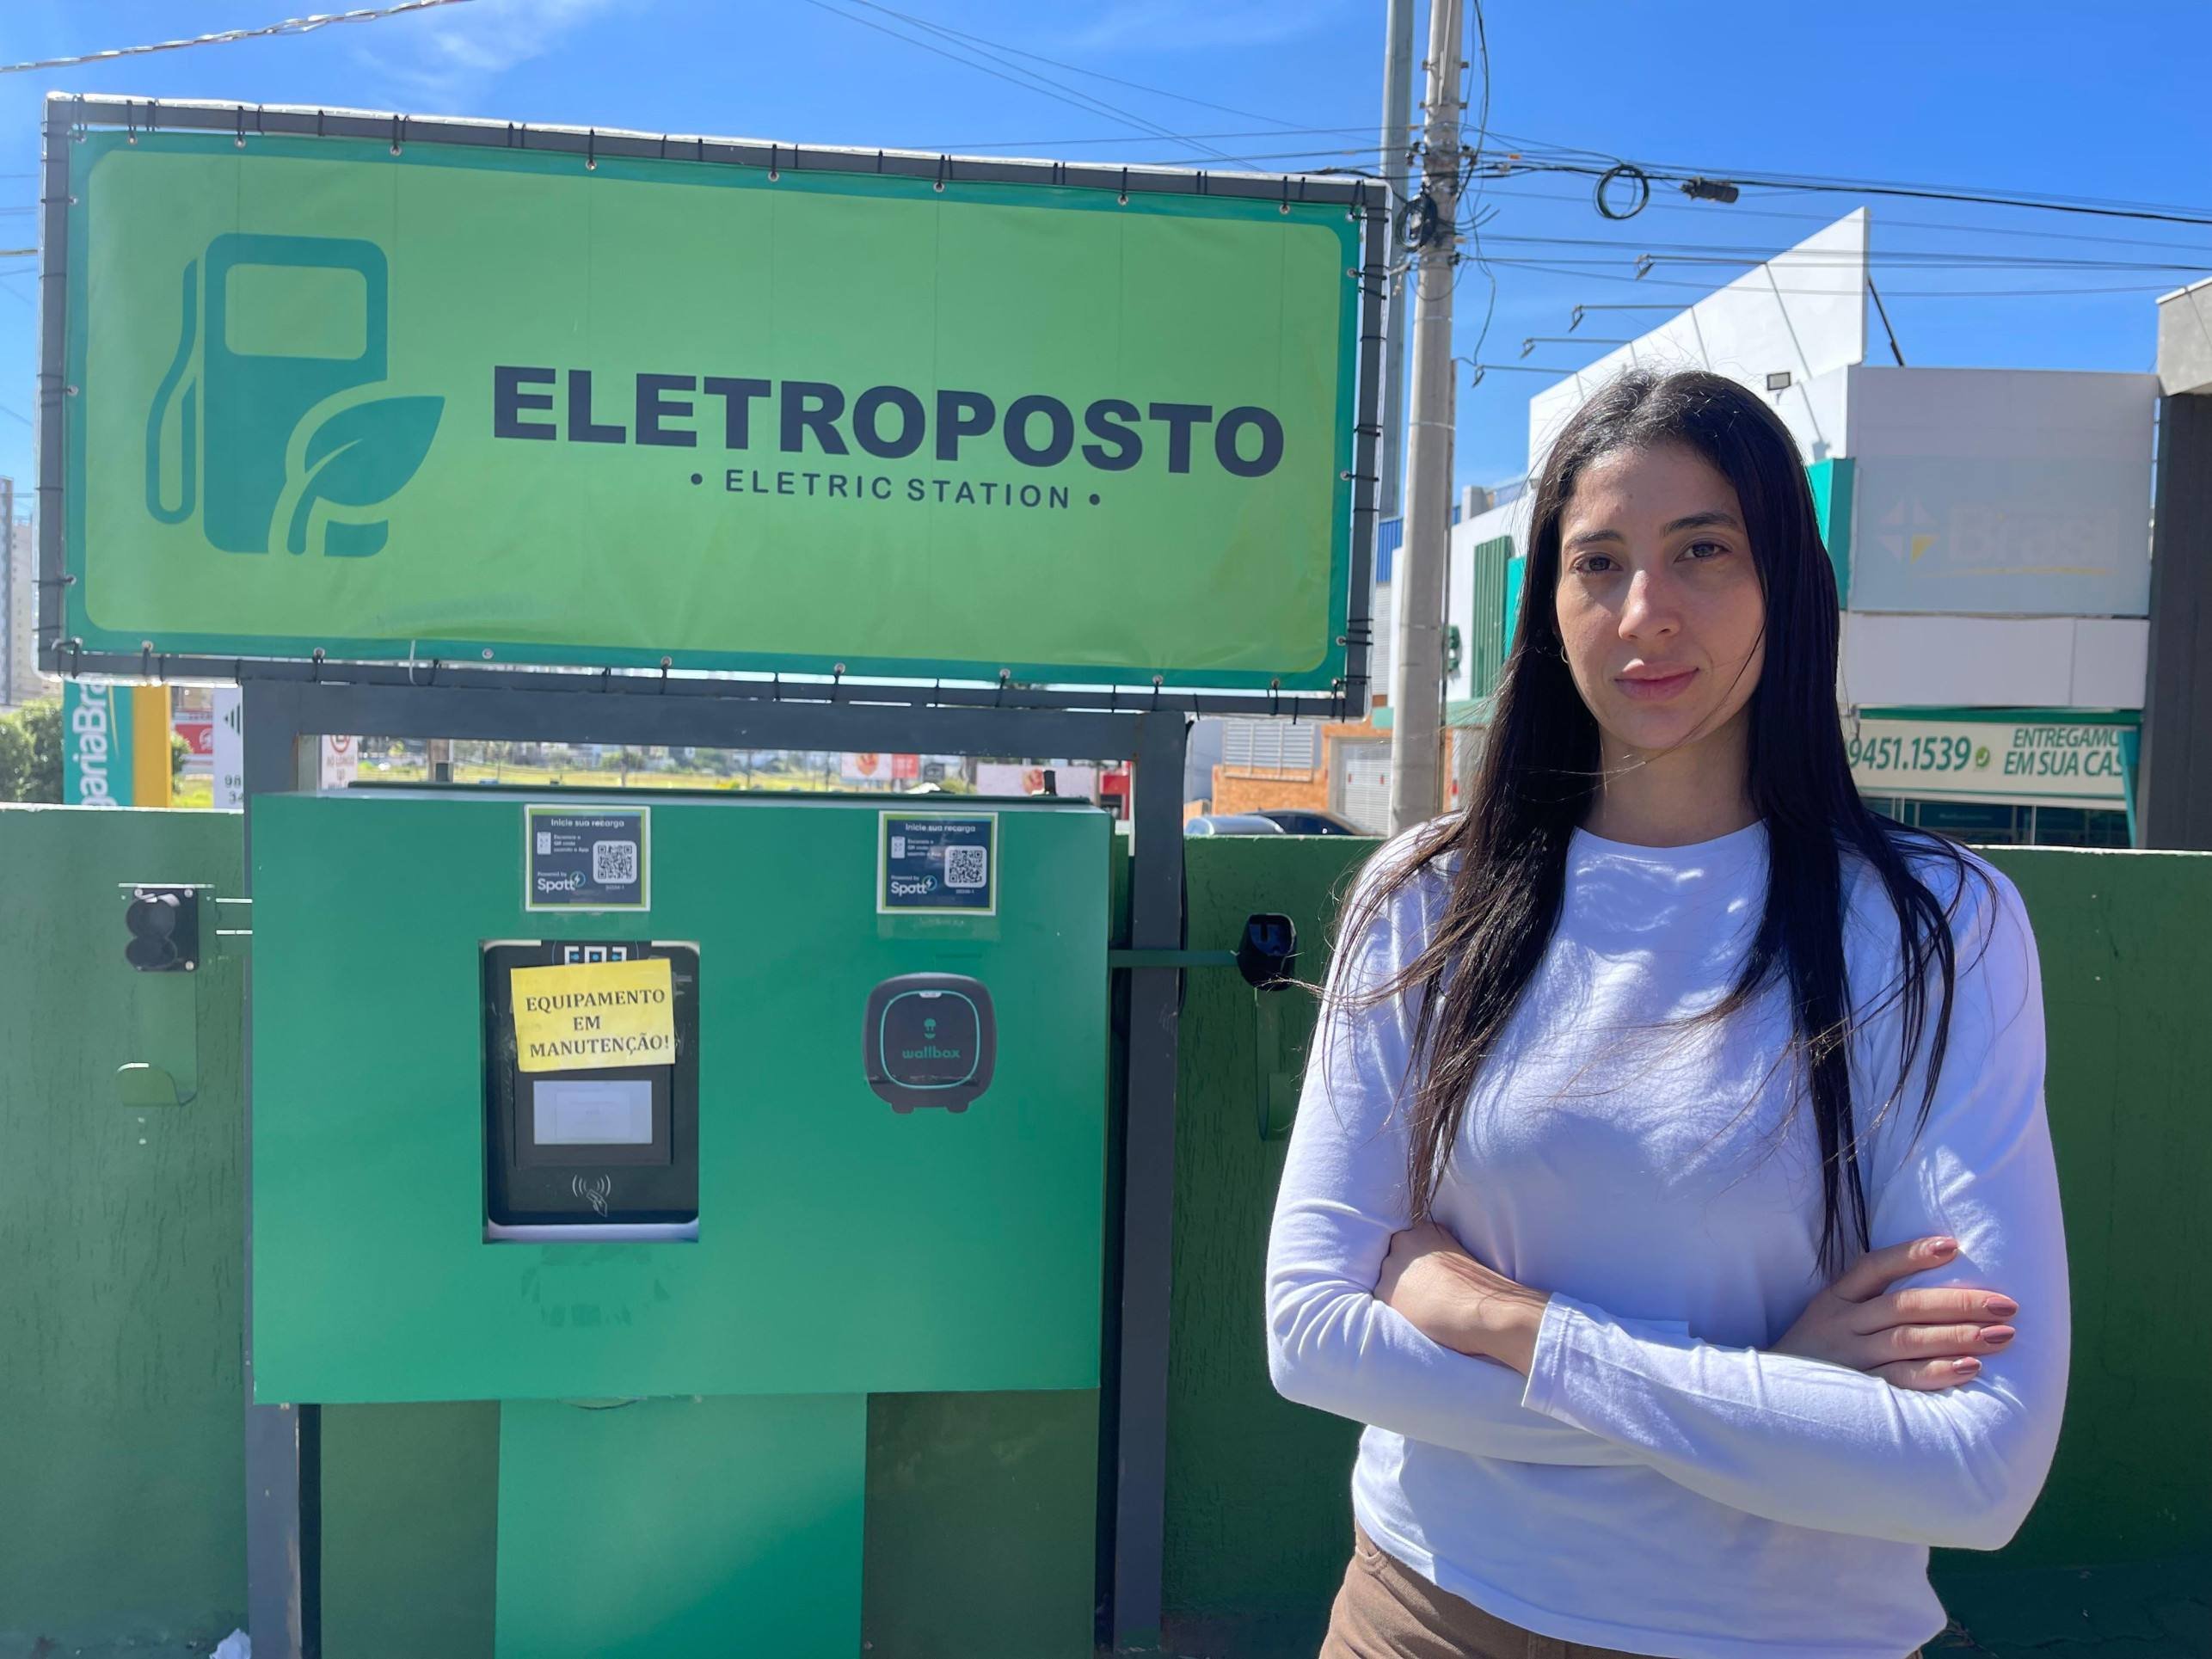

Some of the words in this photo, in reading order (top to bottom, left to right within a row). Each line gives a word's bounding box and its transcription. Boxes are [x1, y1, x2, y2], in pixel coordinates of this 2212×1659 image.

[494, 365, 1284, 477] ELETROPOSTO
[725, 470, 894, 501] ELETRIC
[906, 477, 1071, 509] STATION
[2004, 751, 2036, 775] EM
[2037, 751, 2079, 776] SUA
[550, 818, 574, 827] Inicie
[592, 820, 625, 829] recarga
[905, 823, 926, 832] Inicie
[537, 877, 575, 894] Spott
[891, 882, 927, 897] Spott
[525, 989, 666, 1014] EQUIPAMENTO
[573, 1016, 601, 1032] EM
[529, 1033, 670, 1058] MANUTENÇÃO!
[901, 1046, 961, 1059] wallbox
